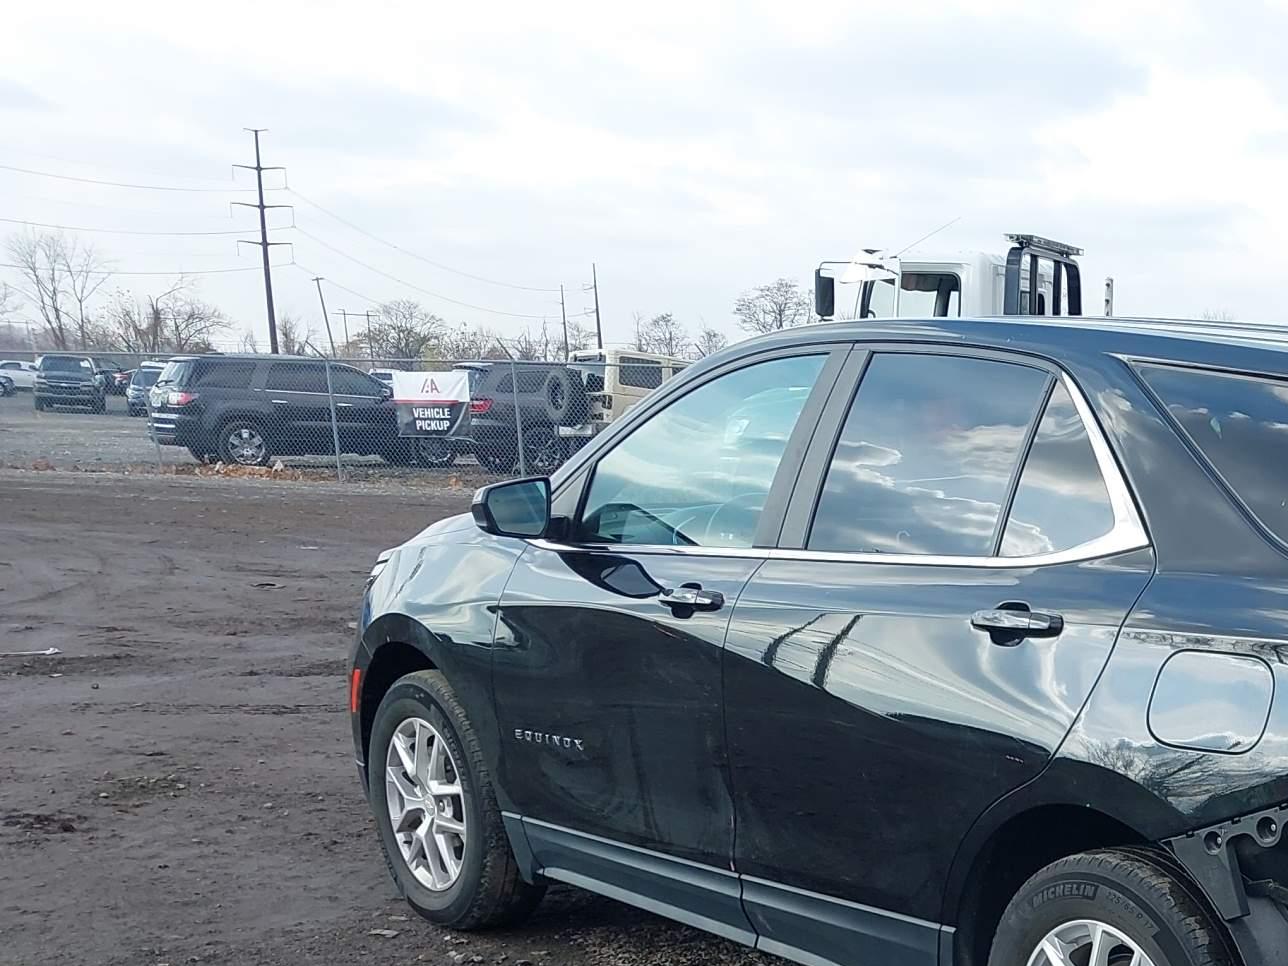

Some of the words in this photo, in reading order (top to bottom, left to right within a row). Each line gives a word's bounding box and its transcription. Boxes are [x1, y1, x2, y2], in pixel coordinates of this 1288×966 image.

[413, 407, 451, 418] VEHICLE
[416, 420, 450, 430] PICKUP
[514, 729, 584, 751] EQUINOX
[1032, 882, 1095, 908] MICHELIN
